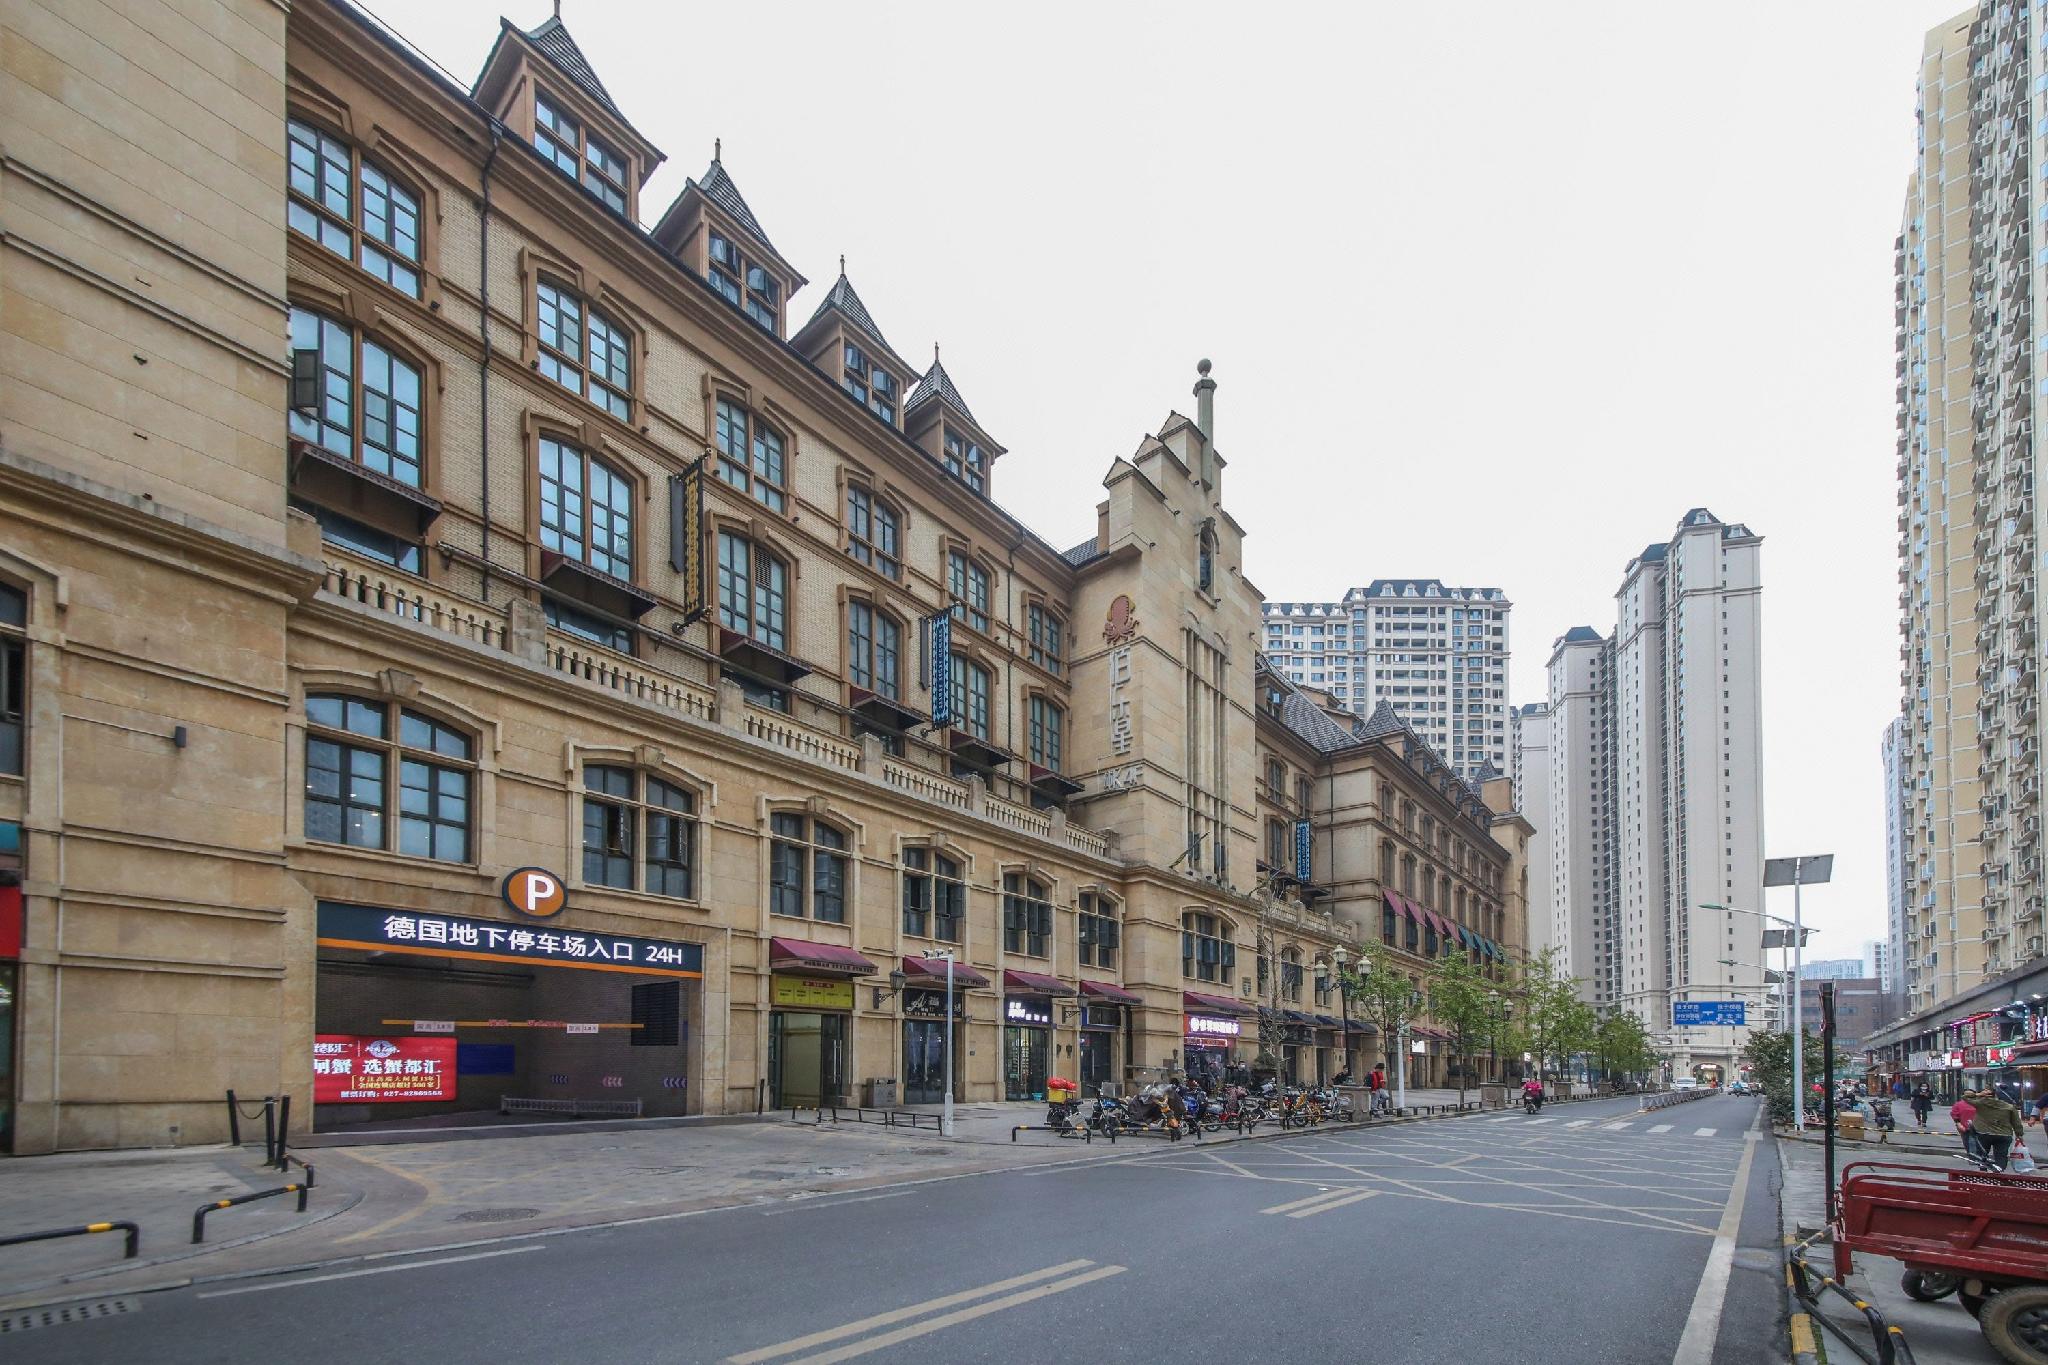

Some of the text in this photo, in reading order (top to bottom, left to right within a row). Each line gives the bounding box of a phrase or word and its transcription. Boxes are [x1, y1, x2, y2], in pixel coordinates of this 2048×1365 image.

[526, 873, 555, 911] P
[383, 914, 683, 965] 德国地下停车场入口 24H
[363, 1058, 443, 1075] 选蟹都汇
